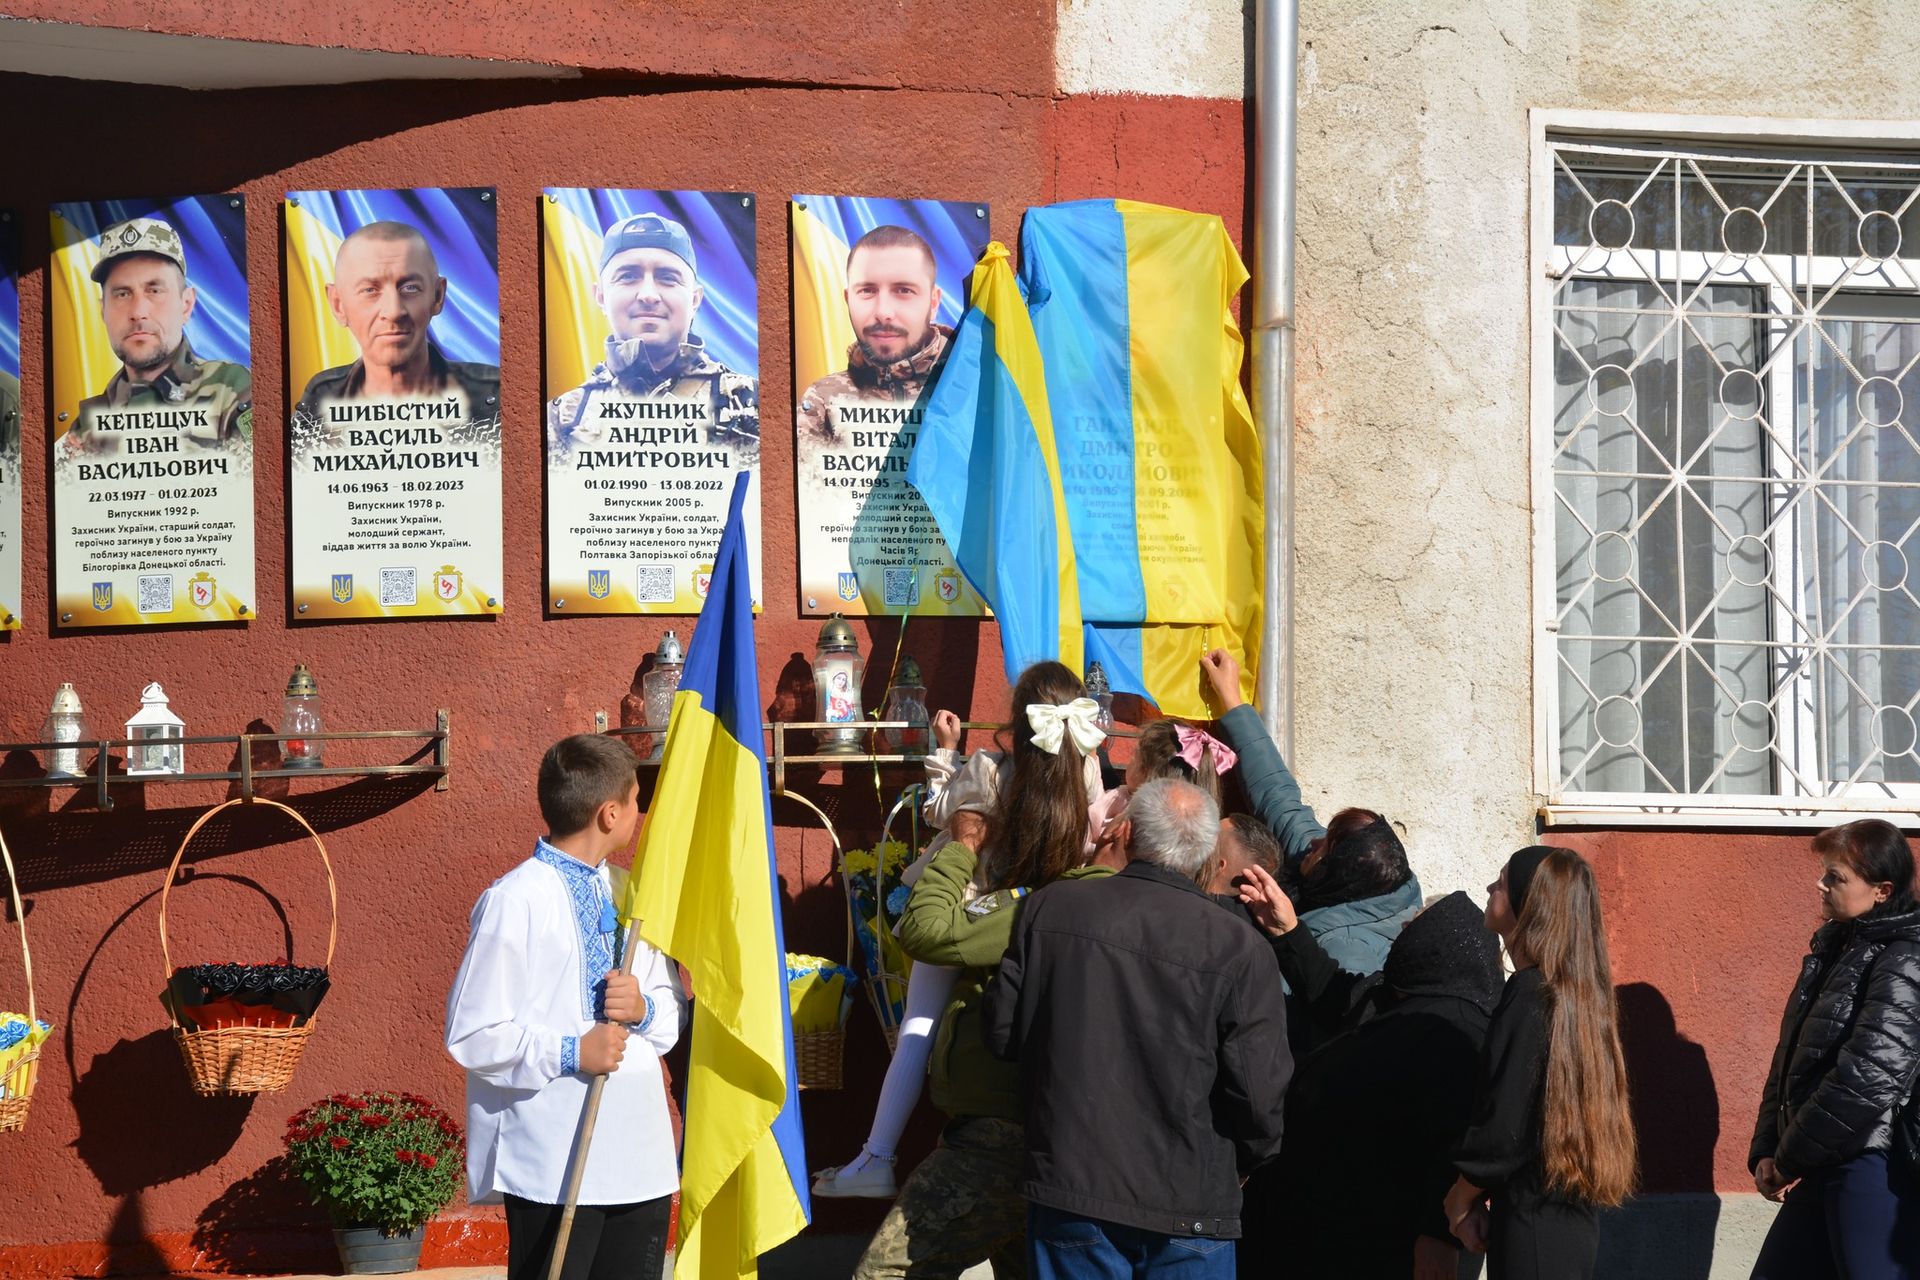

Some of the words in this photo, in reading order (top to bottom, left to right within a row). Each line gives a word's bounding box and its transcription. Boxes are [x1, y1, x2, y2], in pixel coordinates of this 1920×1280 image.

[329, 398, 461, 422] ШИБІСТИЙ
[599, 402, 706, 419] ЖУПНИК
[96, 410, 208, 431] КЕПЕЩУК
[349, 428, 442, 447] ВАСИЛЬ
[609, 424, 698, 446] АНДРІЙ
[126, 437, 179, 454] ІВАН
[313, 449, 479, 472] МИХАЙЛОВИЧ
[577, 450, 730, 470] ДМИТРОВИЧ
[78, 458, 229, 481] ВАСИЛЬОВИЧ
[328, 483, 388, 494] 14.06.1963
[402, 480, 464, 491] 18.02.2023
[584, 480, 647, 490] 01.02.1990
[660, 480, 724, 491] 13.08.2022
[824, 477, 889, 488] 14.07.1995
[88, 491, 146, 502] 22.03.1977
[158, 487, 218, 499] 01.02.2023
[851, 491, 906, 501] Випускник
[348, 501, 404, 511] Випускник
[408, 500, 432, 509] 1978
[435, 501, 445, 509] р.
[604, 498, 662, 509] Випускник
[666, 498, 692, 507] 2005
[695, 499, 704, 509] р.
[856, 503, 900, 511] Захисник
[107, 508, 161, 520] Випускник
[165, 507, 188, 516] 1992
[191, 508, 199, 517] р.
[351, 516, 398, 525] Захисник
[400, 514, 442, 525] України,
[589, 514, 636, 522] Захисник
[639, 513, 681, 524] України,
[684, 515, 720, 524] солдат,
[853, 513, 901, 523] молодший
[71, 526, 115, 536] Захисник
[118, 524, 157, 534] України,
[160, 521, 199, 533] старший
[202, 520, 236, 531] солдат,
[348, 528, 399, 539] молодший
[402, 528, 445, 538] сержант,
[569, 526, 612, 536] героїчно
[615, 527, 654, 535] загинув
[657, 527, 662, 536] у
[665, 526, 685, 534] бою
[700, 526, 725, 535] Укра
[820, 525, 860, 534] героїчно
[863, 526, 899, 534] загинув
[902, 526, 907, 535] у
[75, 538, 115, 549] героїчно
[117, 536, 154, 547] загинув
[156, 538, 161, 546] у
[163, 535, 182, 544] бою
[197, 533, 233, 544] Україну
[322, 542, 354, 552] віддав
[357, 542, 386, 550] життя
[402, 541, 427, 549] волю
[430, 539, 471, 549] України.
[586, 539, 627, 548] поблизу
[630, 539, 686, 547] населеного
[832, 535, 879, 544] неподалік
[881, 537, 933, 545] населеного
[90, 550, 128, 560] поблизу
[131, 548, 183, 558] населеного
[186, 547, 218, 556] пункту
[580, 551, 627, 559] Полтавка
[630, 551, 687, 561] Запорізької
[881, 546, 905, 555] Часів
[82, 562, 136, 573] Білогорівка
[138, 560, 187, 570] Донецької
[189, 558, 226, 568] області.
[857, 557, 905, 567] Донецької
